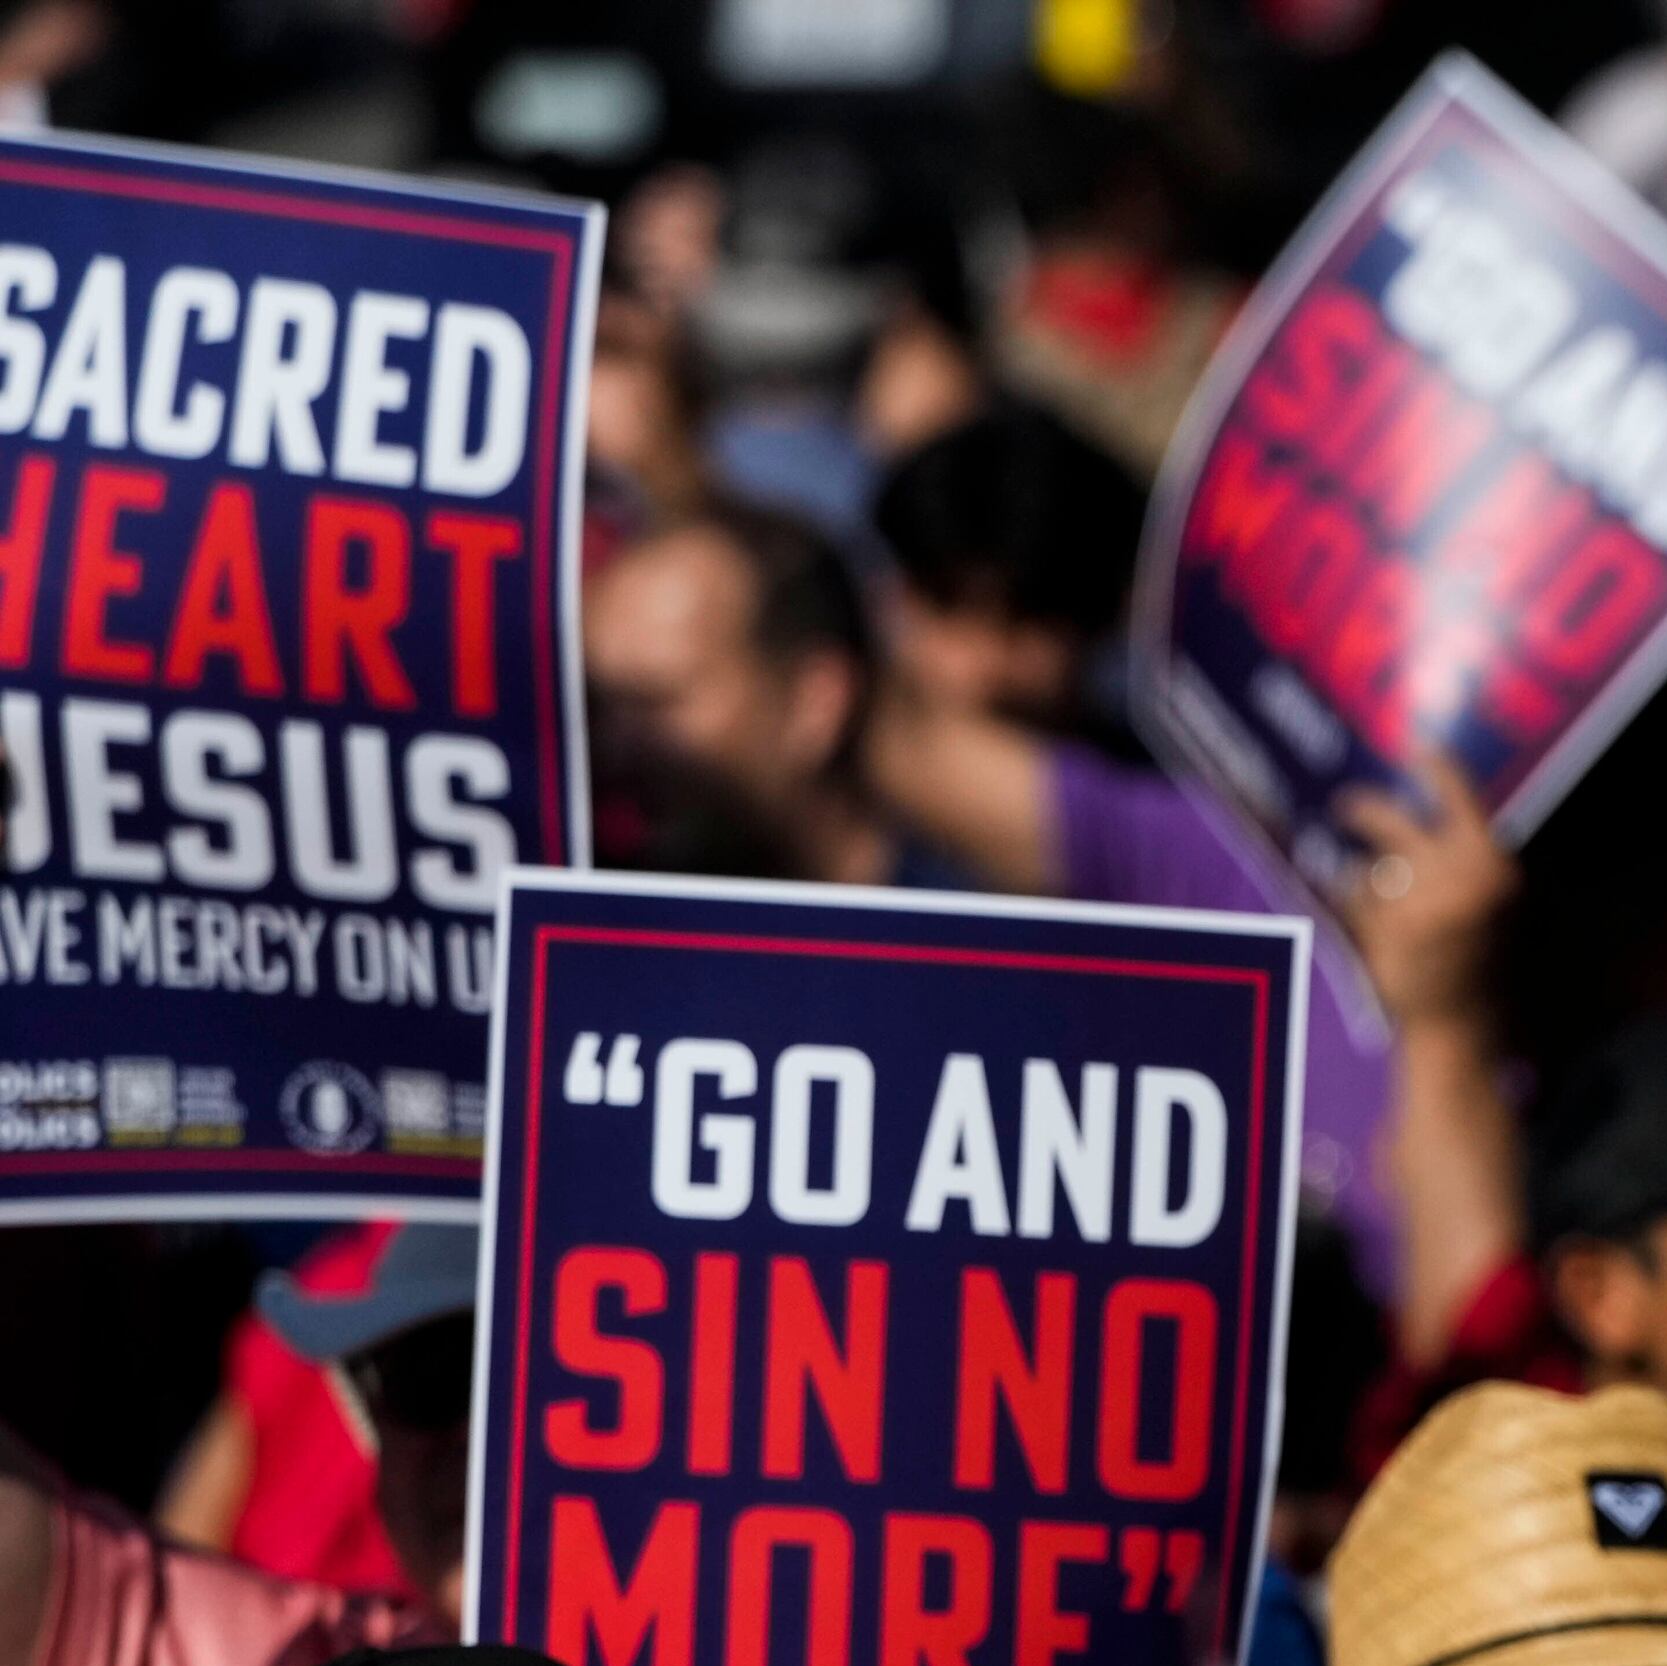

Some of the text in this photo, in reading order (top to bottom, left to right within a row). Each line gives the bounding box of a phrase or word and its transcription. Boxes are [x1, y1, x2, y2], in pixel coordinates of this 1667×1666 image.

[0, 242, 532, 499] SACRED
[0, 688, 518, 914] JESUS
[98, 890, 326, 998] MERCY
[333, 911, 437, 1008] ON
[446, 924, 493, 1016] U
[905, 1052, 1229, 1249] AND
[543, 1244, 1220, 1503] SIN NO
